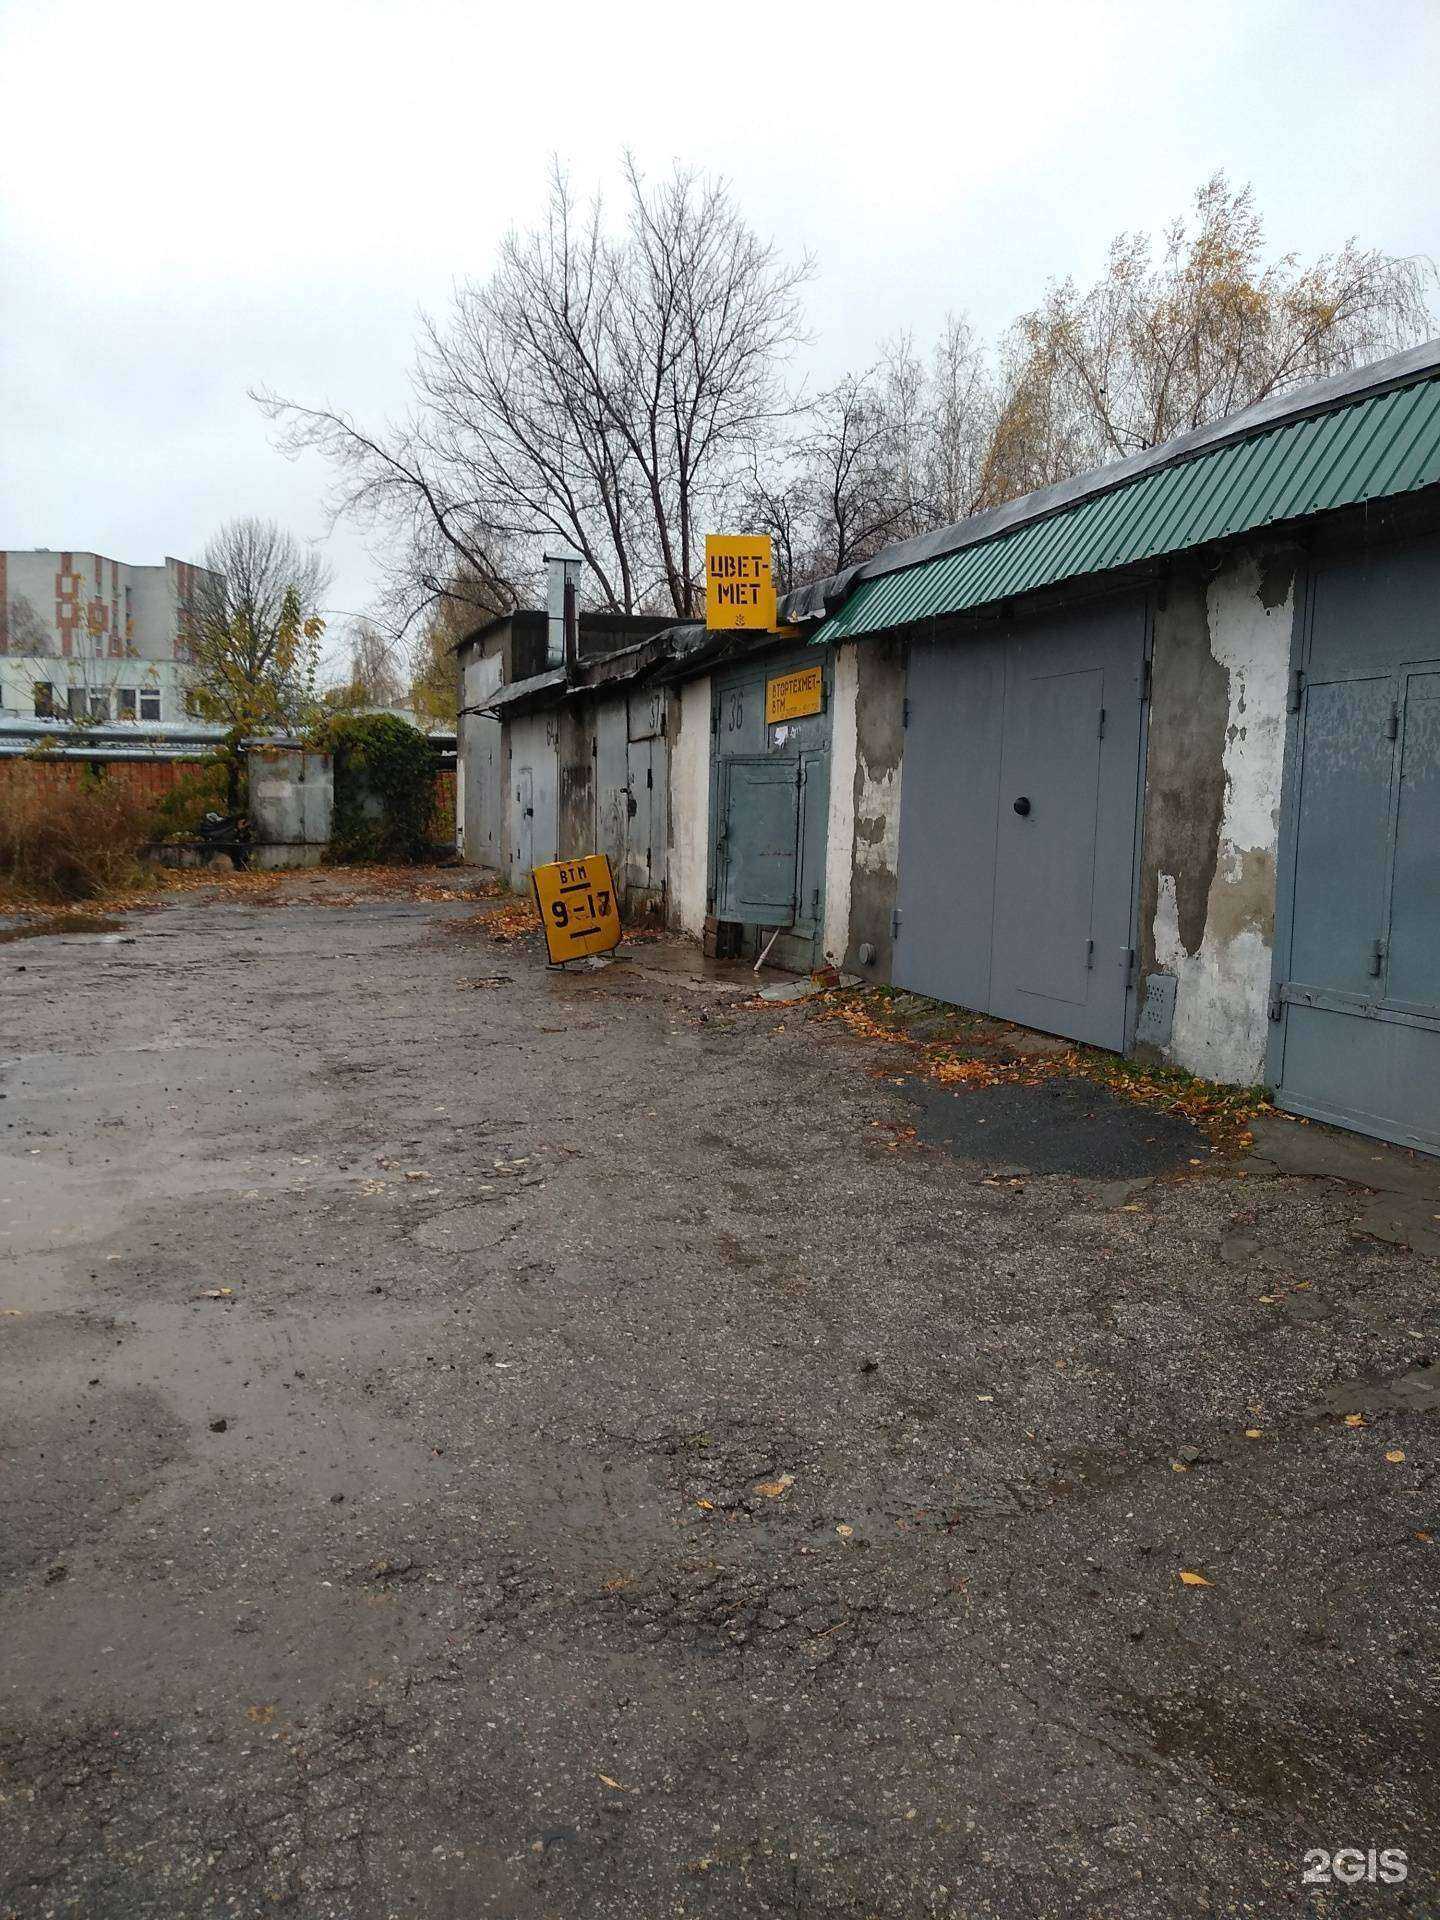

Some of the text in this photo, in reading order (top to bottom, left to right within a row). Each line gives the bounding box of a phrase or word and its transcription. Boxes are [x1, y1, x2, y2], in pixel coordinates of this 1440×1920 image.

[710, 556, 769, 578] ЦВЕТ-
[717, 583, 761, 605] МЕТ
[559, 866, 588, 884] ВТМ
